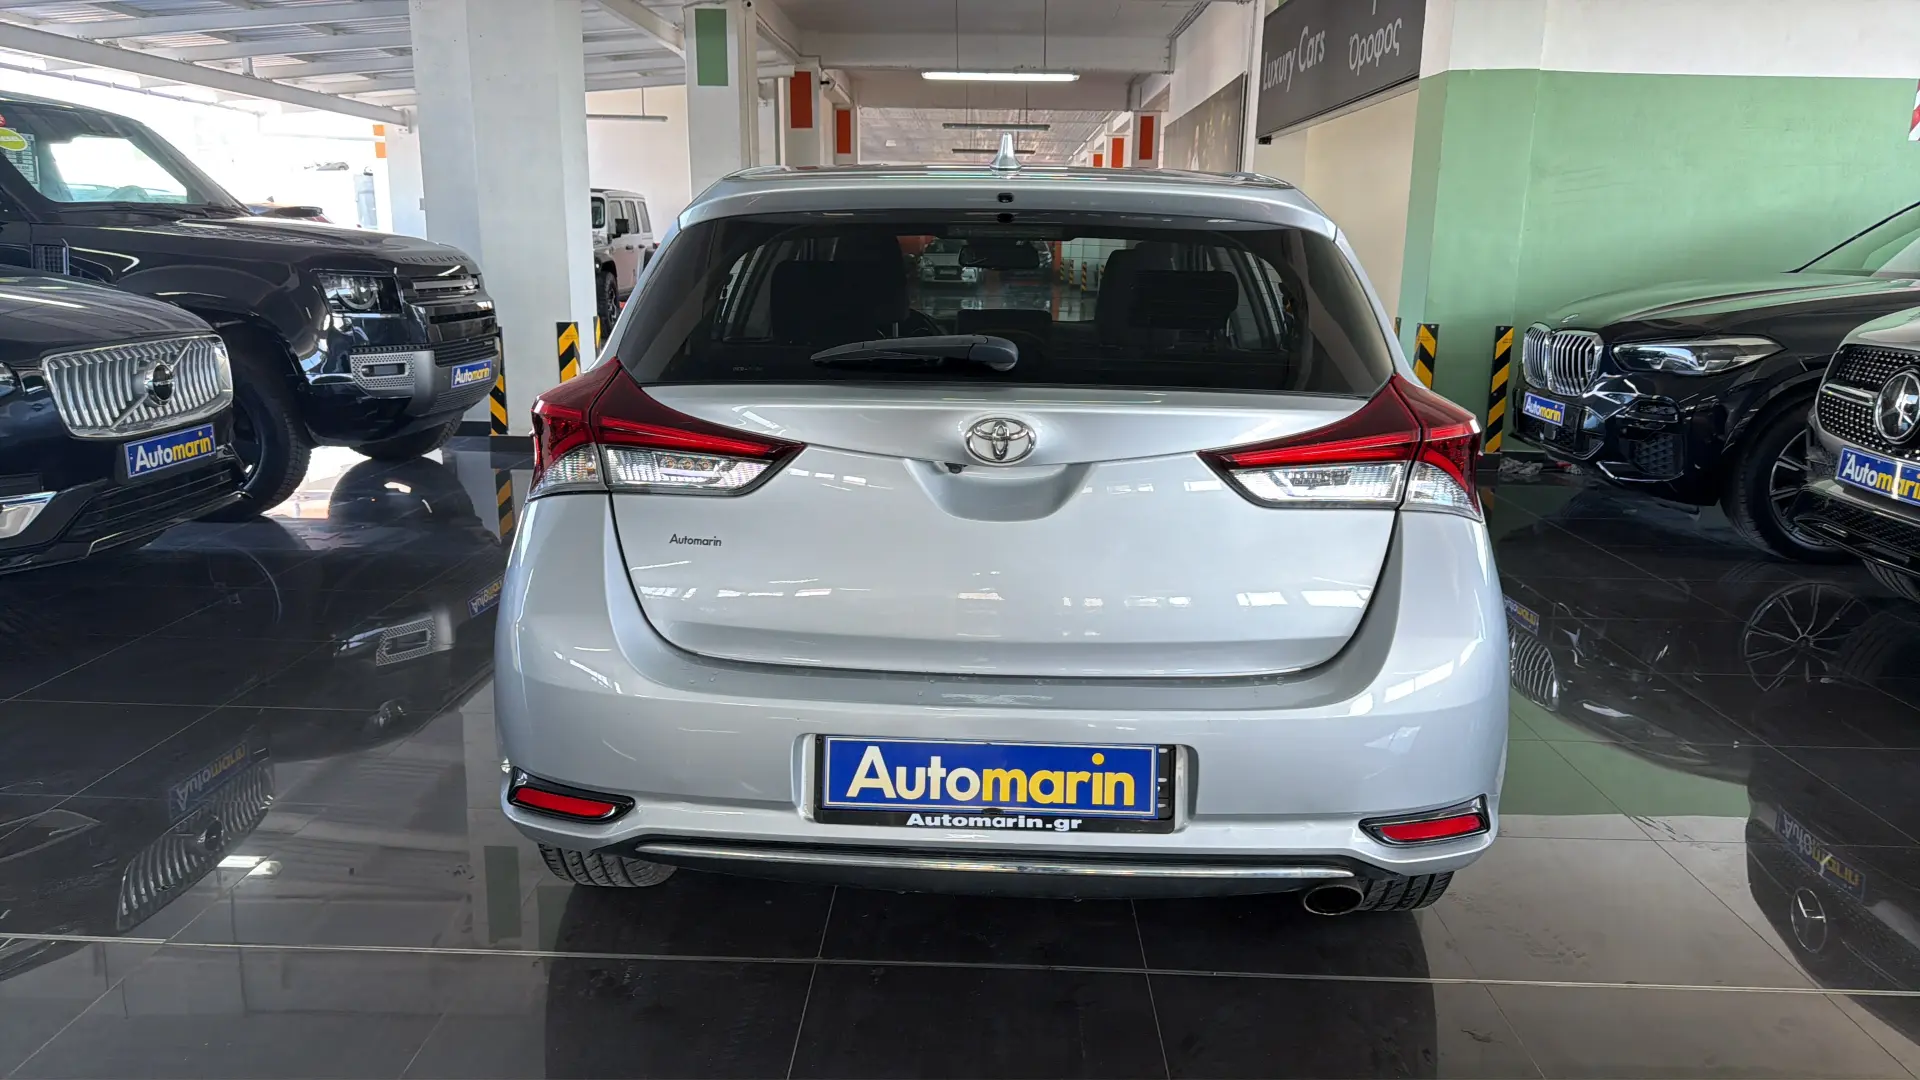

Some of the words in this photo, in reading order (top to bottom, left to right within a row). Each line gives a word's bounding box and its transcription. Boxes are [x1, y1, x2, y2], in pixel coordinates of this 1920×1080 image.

[1263, 48, 1296, 93] Luxury
[1298, 26, 1326, 72] Cars
[135, 431, 211, 472] Automarin
[1841, 454, 1920, 500] Automri
[669, 533, 722, 547] Automarin
[846, 745, 1135, 806] Automarin
[906, 813, 1082, 831] Automarin.gr
